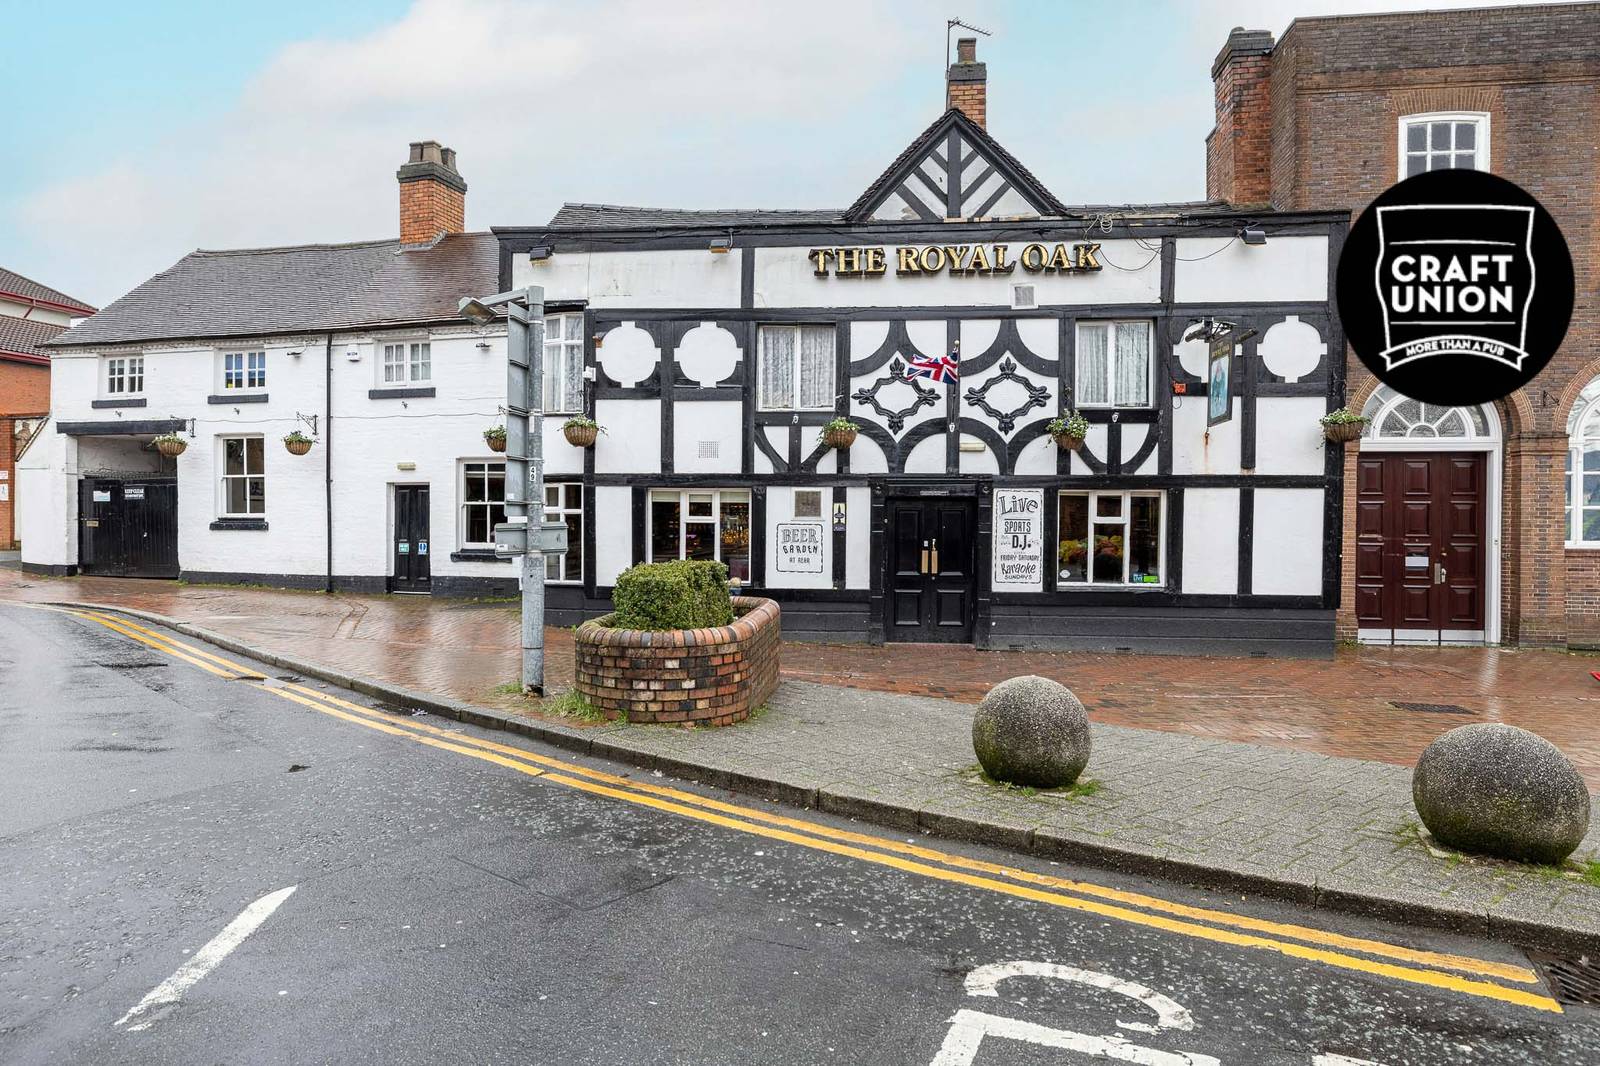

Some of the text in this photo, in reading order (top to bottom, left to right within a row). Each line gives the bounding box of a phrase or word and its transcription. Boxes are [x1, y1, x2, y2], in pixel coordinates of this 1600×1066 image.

[808, 243, 1103, 276] THE ROYAL OAK
[999, 495, 1039, 515] Live
[1004, 521, 1032, 533] SPORTS
[781, 528, 819, 543] BEER
[1012, 534, 1032, 550] D.J.
[782, 544, 818, 554] GARDEN
[1000, 562, 1037, 575] Karaoke
